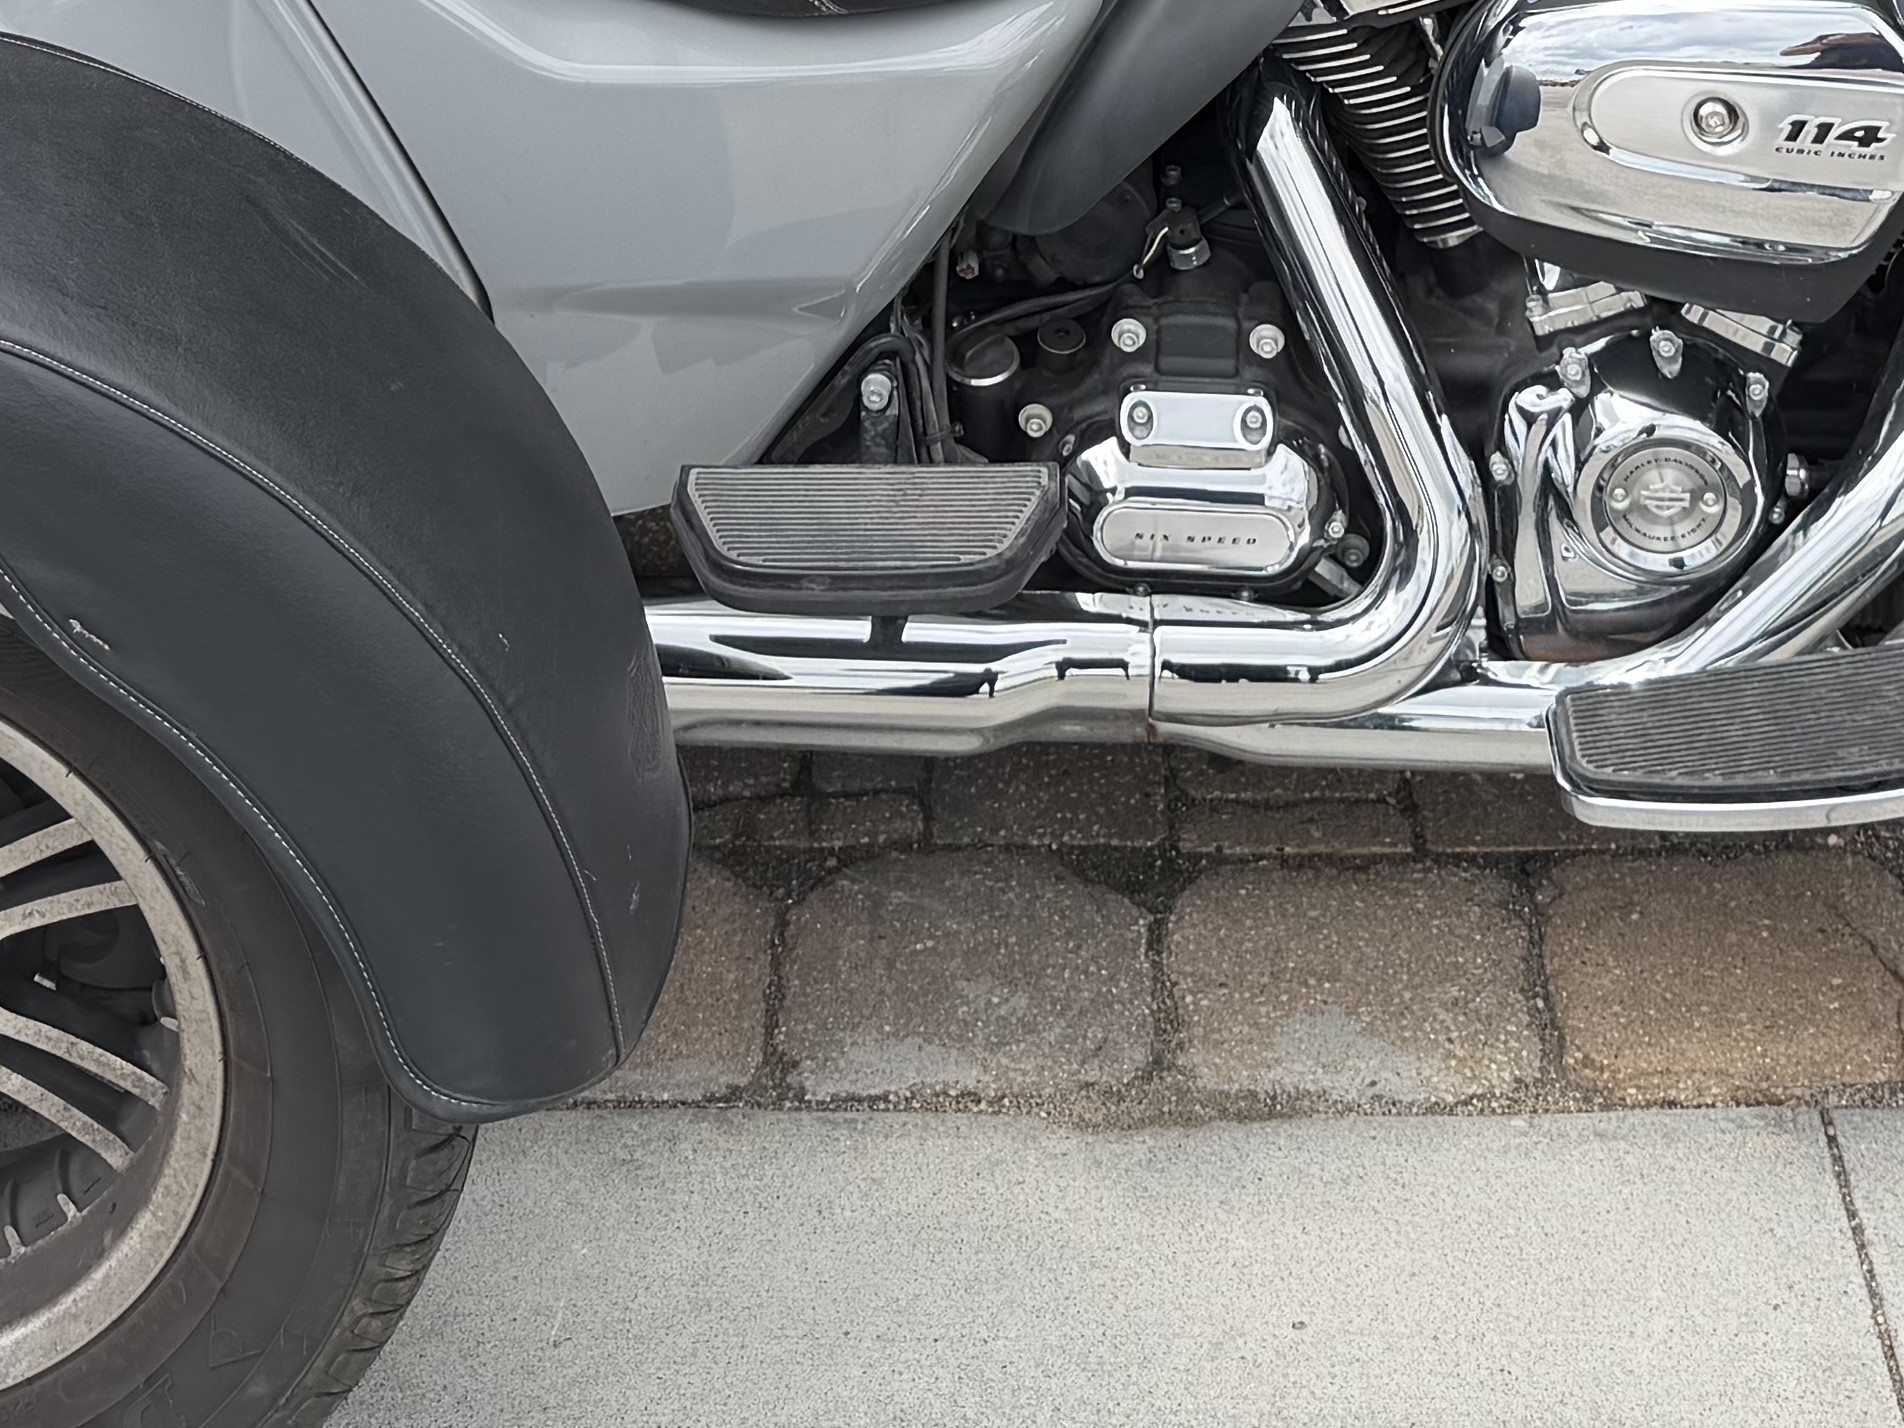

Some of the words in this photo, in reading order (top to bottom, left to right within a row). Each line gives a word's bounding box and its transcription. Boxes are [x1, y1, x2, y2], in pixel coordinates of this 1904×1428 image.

[1779, 115, 1893, 150] 114
[1774, 146, 1823, 157] CUBIC
[1829, 150, 1886, 161] INCHES
[1134, 532, 1172, 542] SIX
[1185, 535, 1258, 545] SPEED
